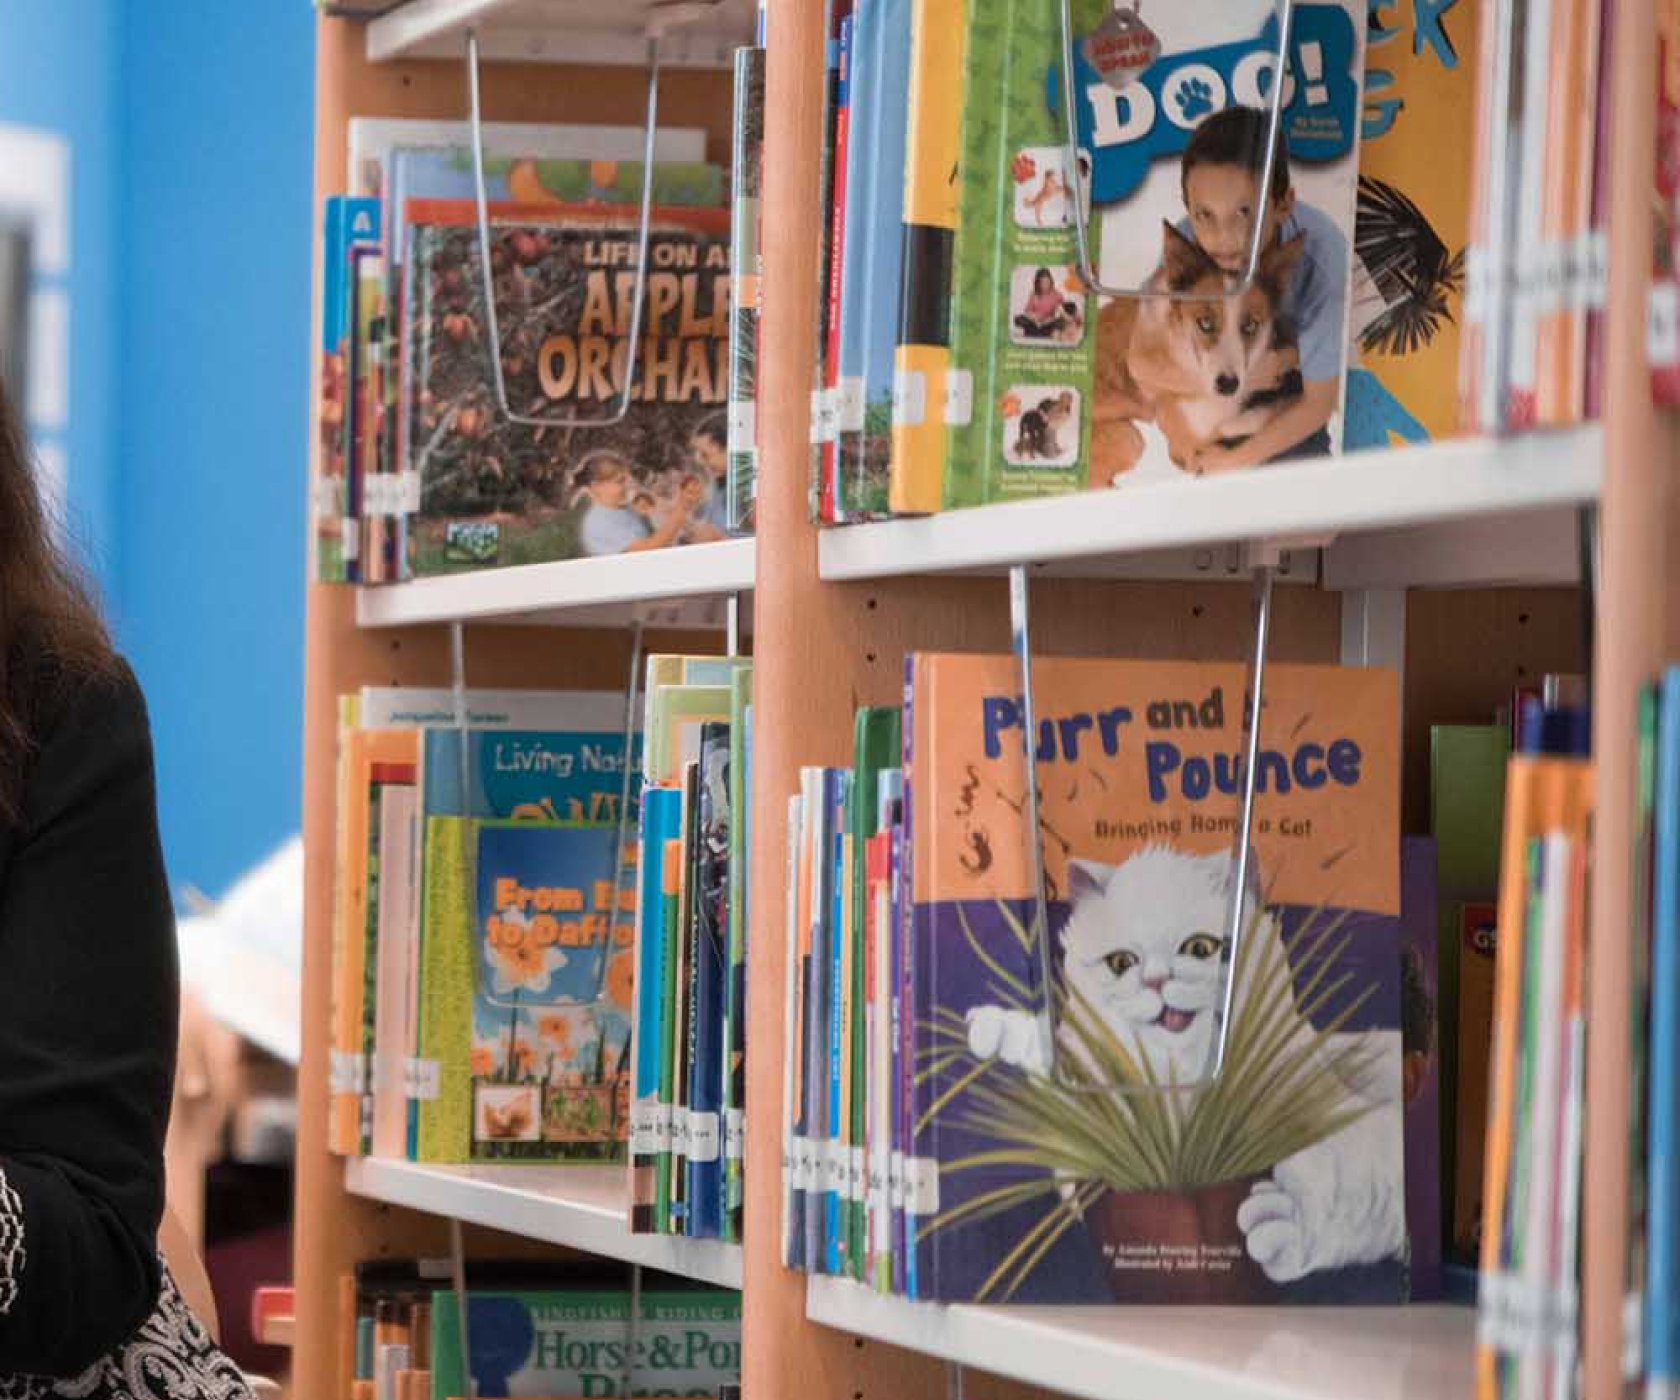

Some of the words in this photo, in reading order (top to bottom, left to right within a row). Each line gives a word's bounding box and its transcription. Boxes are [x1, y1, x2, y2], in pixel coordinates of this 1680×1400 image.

[352, 210, 371, 232] A
[653, 242, 698, 267] ON
[981, 696, 1132, 763] Purr
[1146, 689, 1224, 731] and
[496, 742, 572, 777] Living
[1145, 738, 1362, 803] Pounce
[1094, 817, 1182, 839] Bringing
[1191, 814, 1244, 834] Hom
[1279, 816, 1313, 838] Cat
[495, 877, 584, 912] From
[485, 913, 523, 948] to
[535, 1330, 646, 1371] Horse
